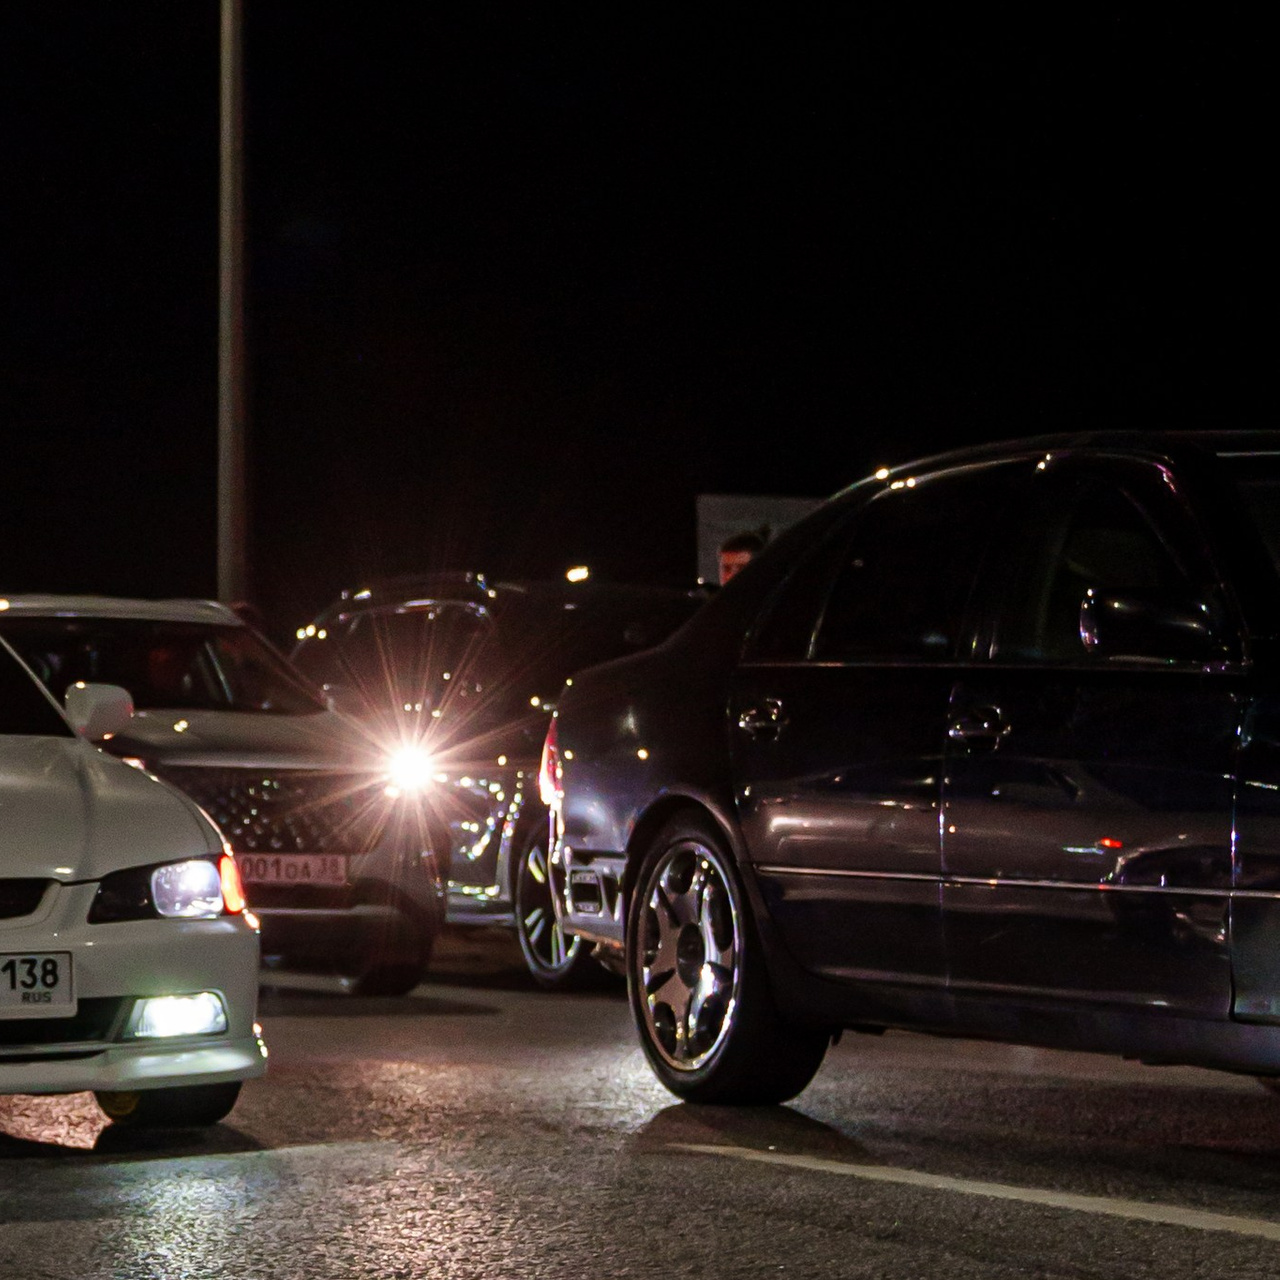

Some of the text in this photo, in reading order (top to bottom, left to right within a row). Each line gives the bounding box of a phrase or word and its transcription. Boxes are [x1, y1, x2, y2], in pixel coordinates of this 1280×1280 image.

[241, 856, 311, 880] 001ОА
[1, 958, 59, 990] 138
[21, 991, 52, 1003] RUS
